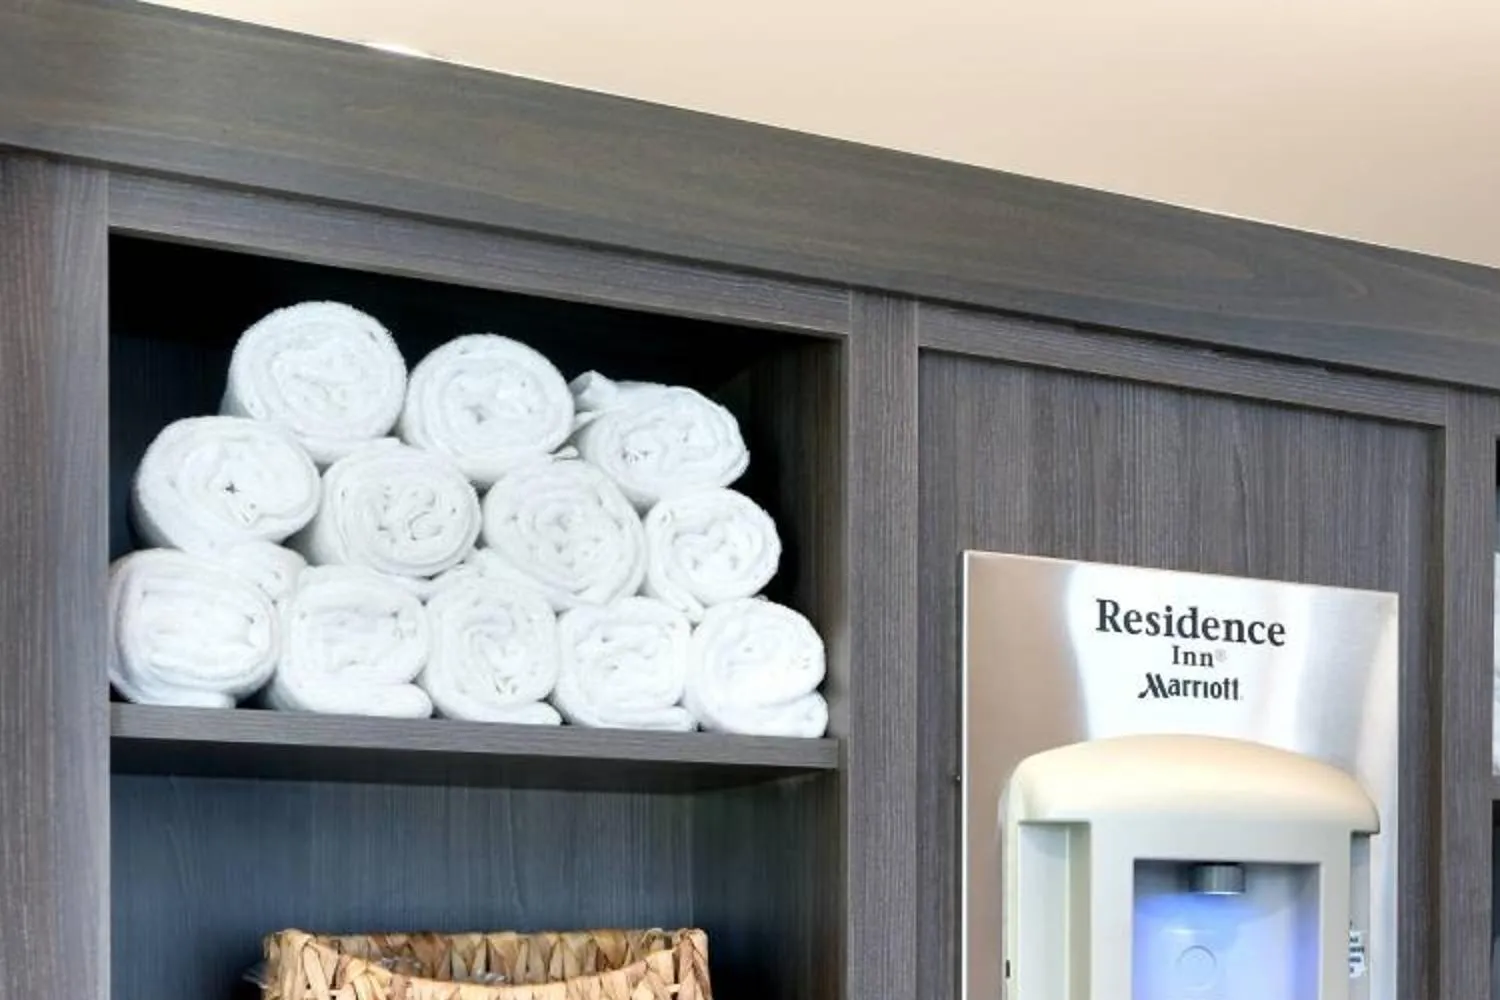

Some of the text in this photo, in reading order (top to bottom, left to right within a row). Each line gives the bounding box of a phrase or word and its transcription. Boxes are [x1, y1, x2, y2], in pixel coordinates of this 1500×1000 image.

[1096, 598, 1287, 647] Residence
[1172, 645, 1214, 668] Inn
[1138, 672, 1239, 700] Marriott
